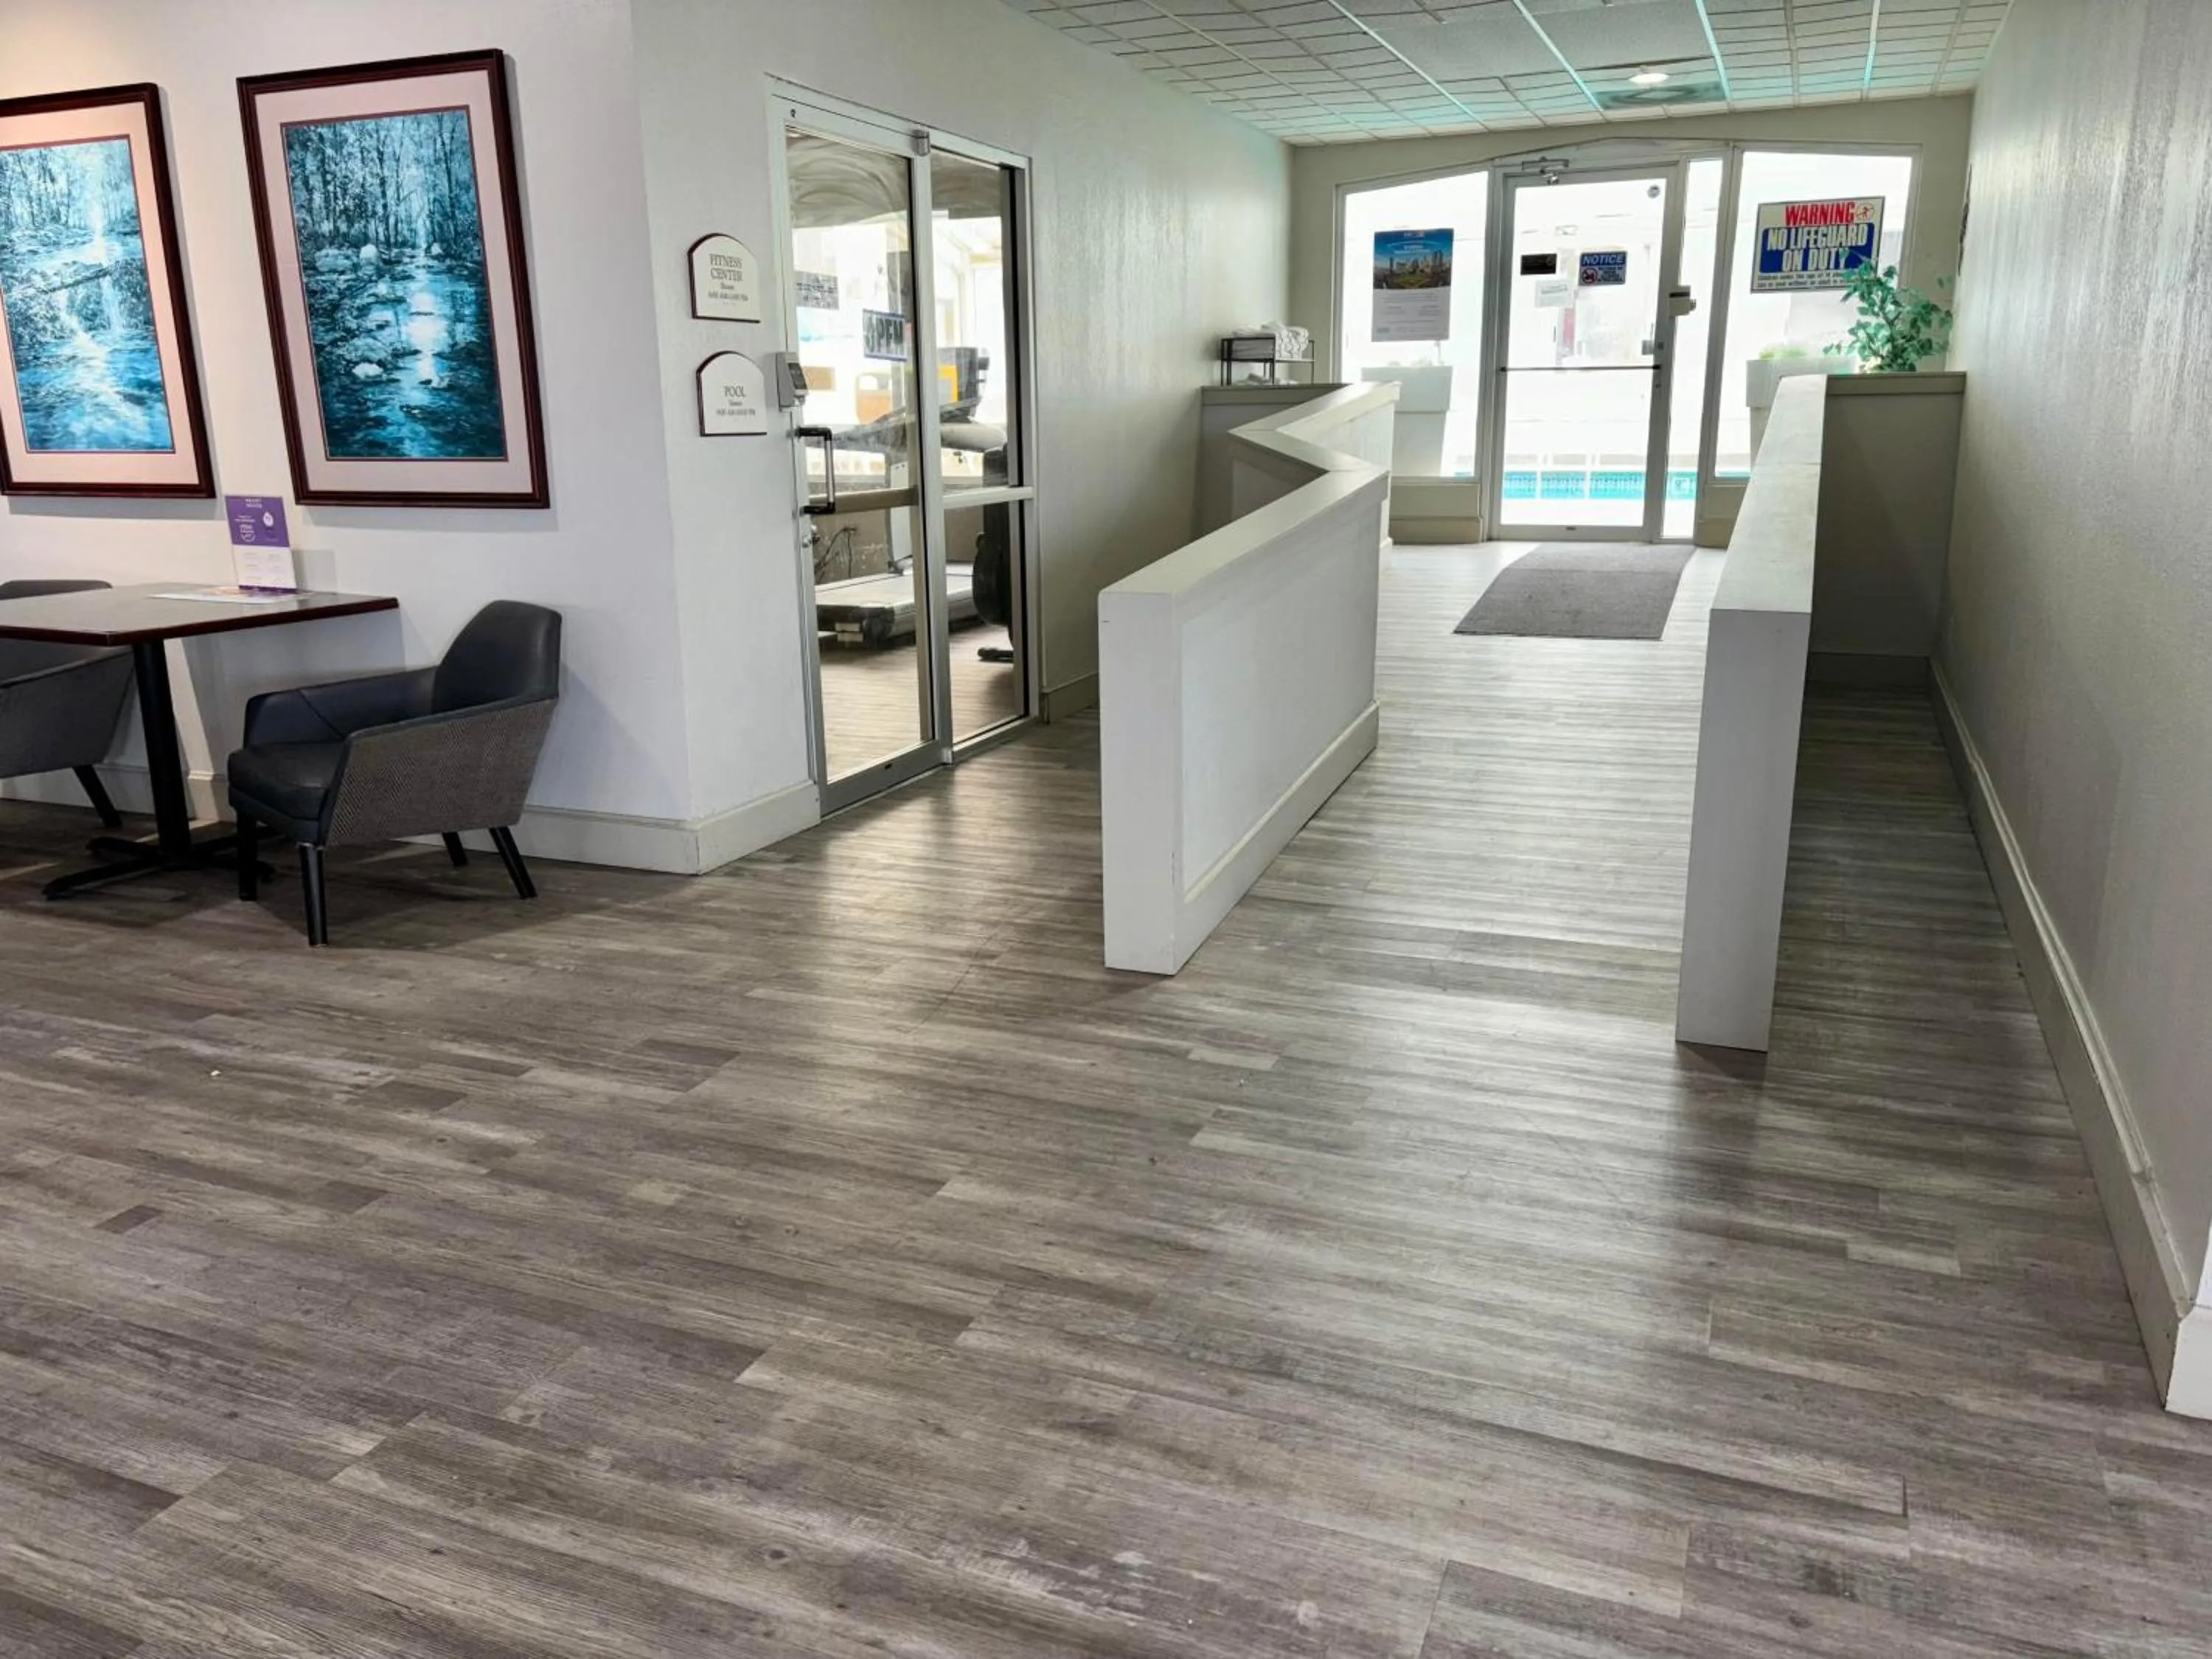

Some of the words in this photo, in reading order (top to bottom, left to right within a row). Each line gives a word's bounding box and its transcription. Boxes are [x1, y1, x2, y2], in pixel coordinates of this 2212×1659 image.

[1785, 201, 1856, 226] WARNING
[1767, 228, 1787, 250] NO
[1790, 224, 1868, 248] LIFEGUARD
[710, 254, 742, 268] FITNESS
[1582, 254, 1625, 265] NOTICE
[1781, 248, 1804, 272] ON
[710, 268, 744, 282] CENTER
[723, 385, 746, 397] POOL
